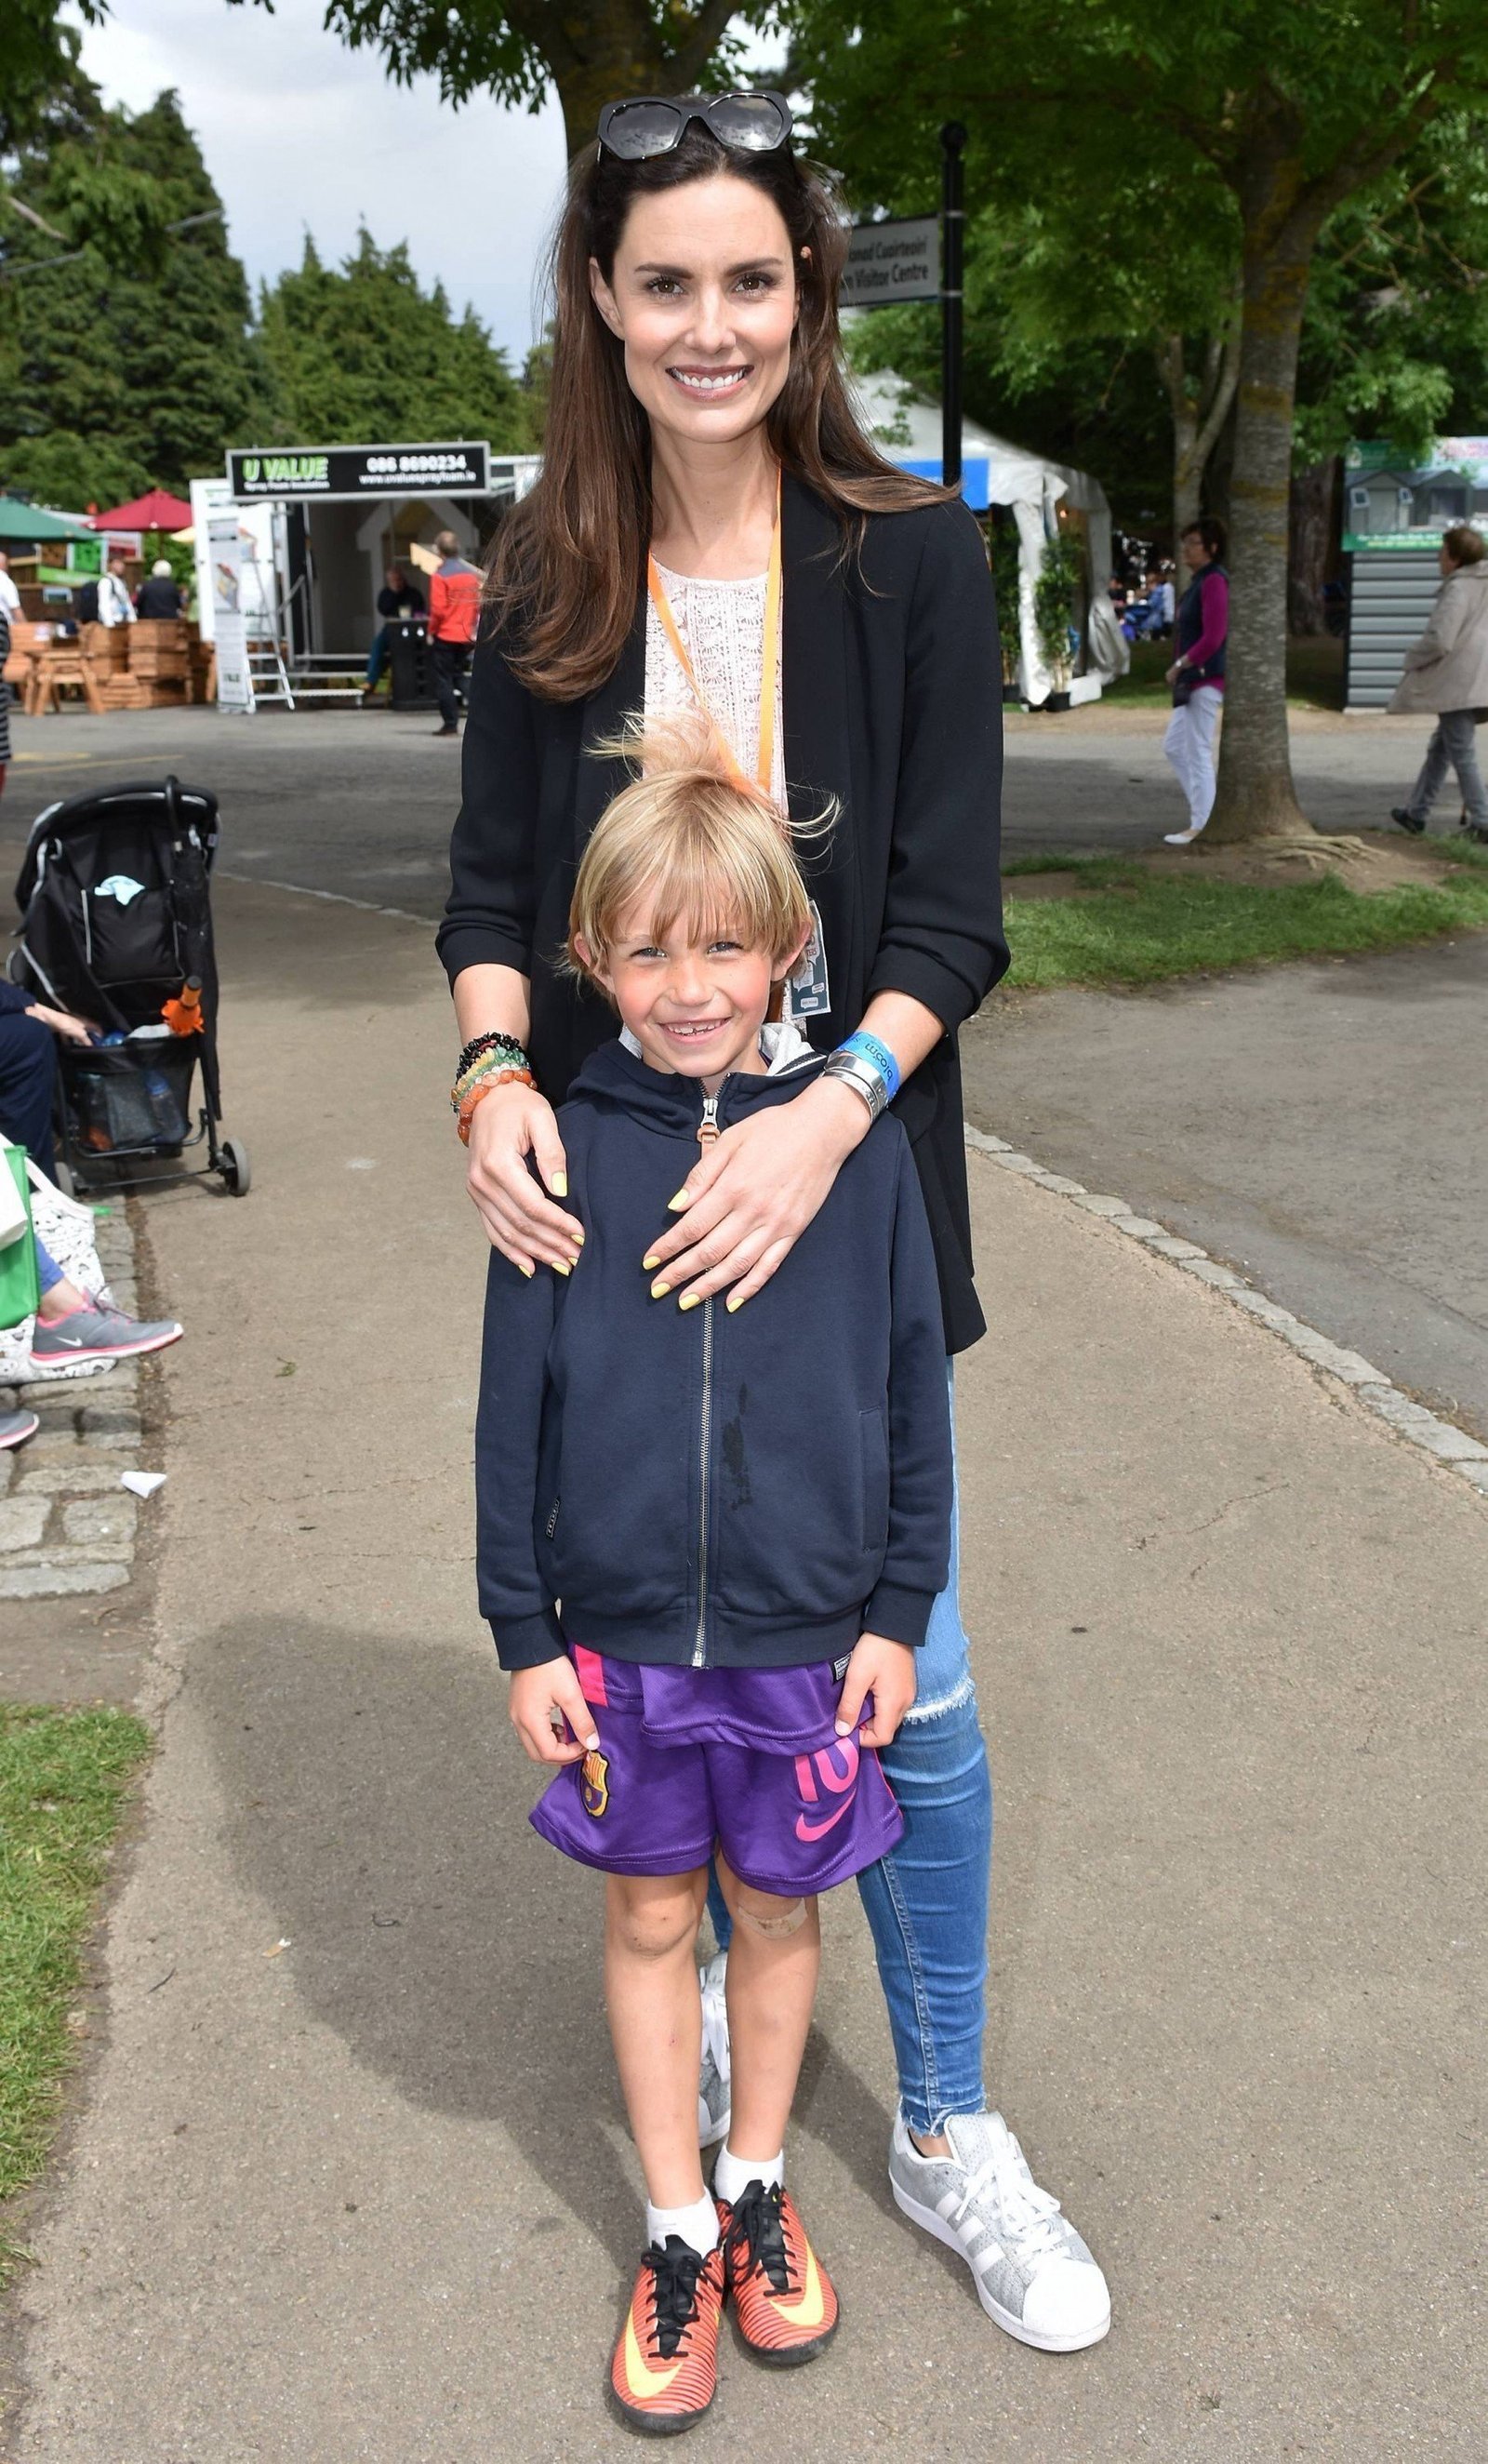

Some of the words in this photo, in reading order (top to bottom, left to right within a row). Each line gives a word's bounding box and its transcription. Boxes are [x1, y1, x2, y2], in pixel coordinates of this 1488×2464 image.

[848, 242, 874, 261] onad
[855, 267, 890, 288] Visitor
[892, 262, 929, 284] Centre
[243, 458, 260, 482] U
[262, 456, 328, 481] VALUE
[366, 456, 398, 473] 086
[794, 1737, 860, 1803] 10
